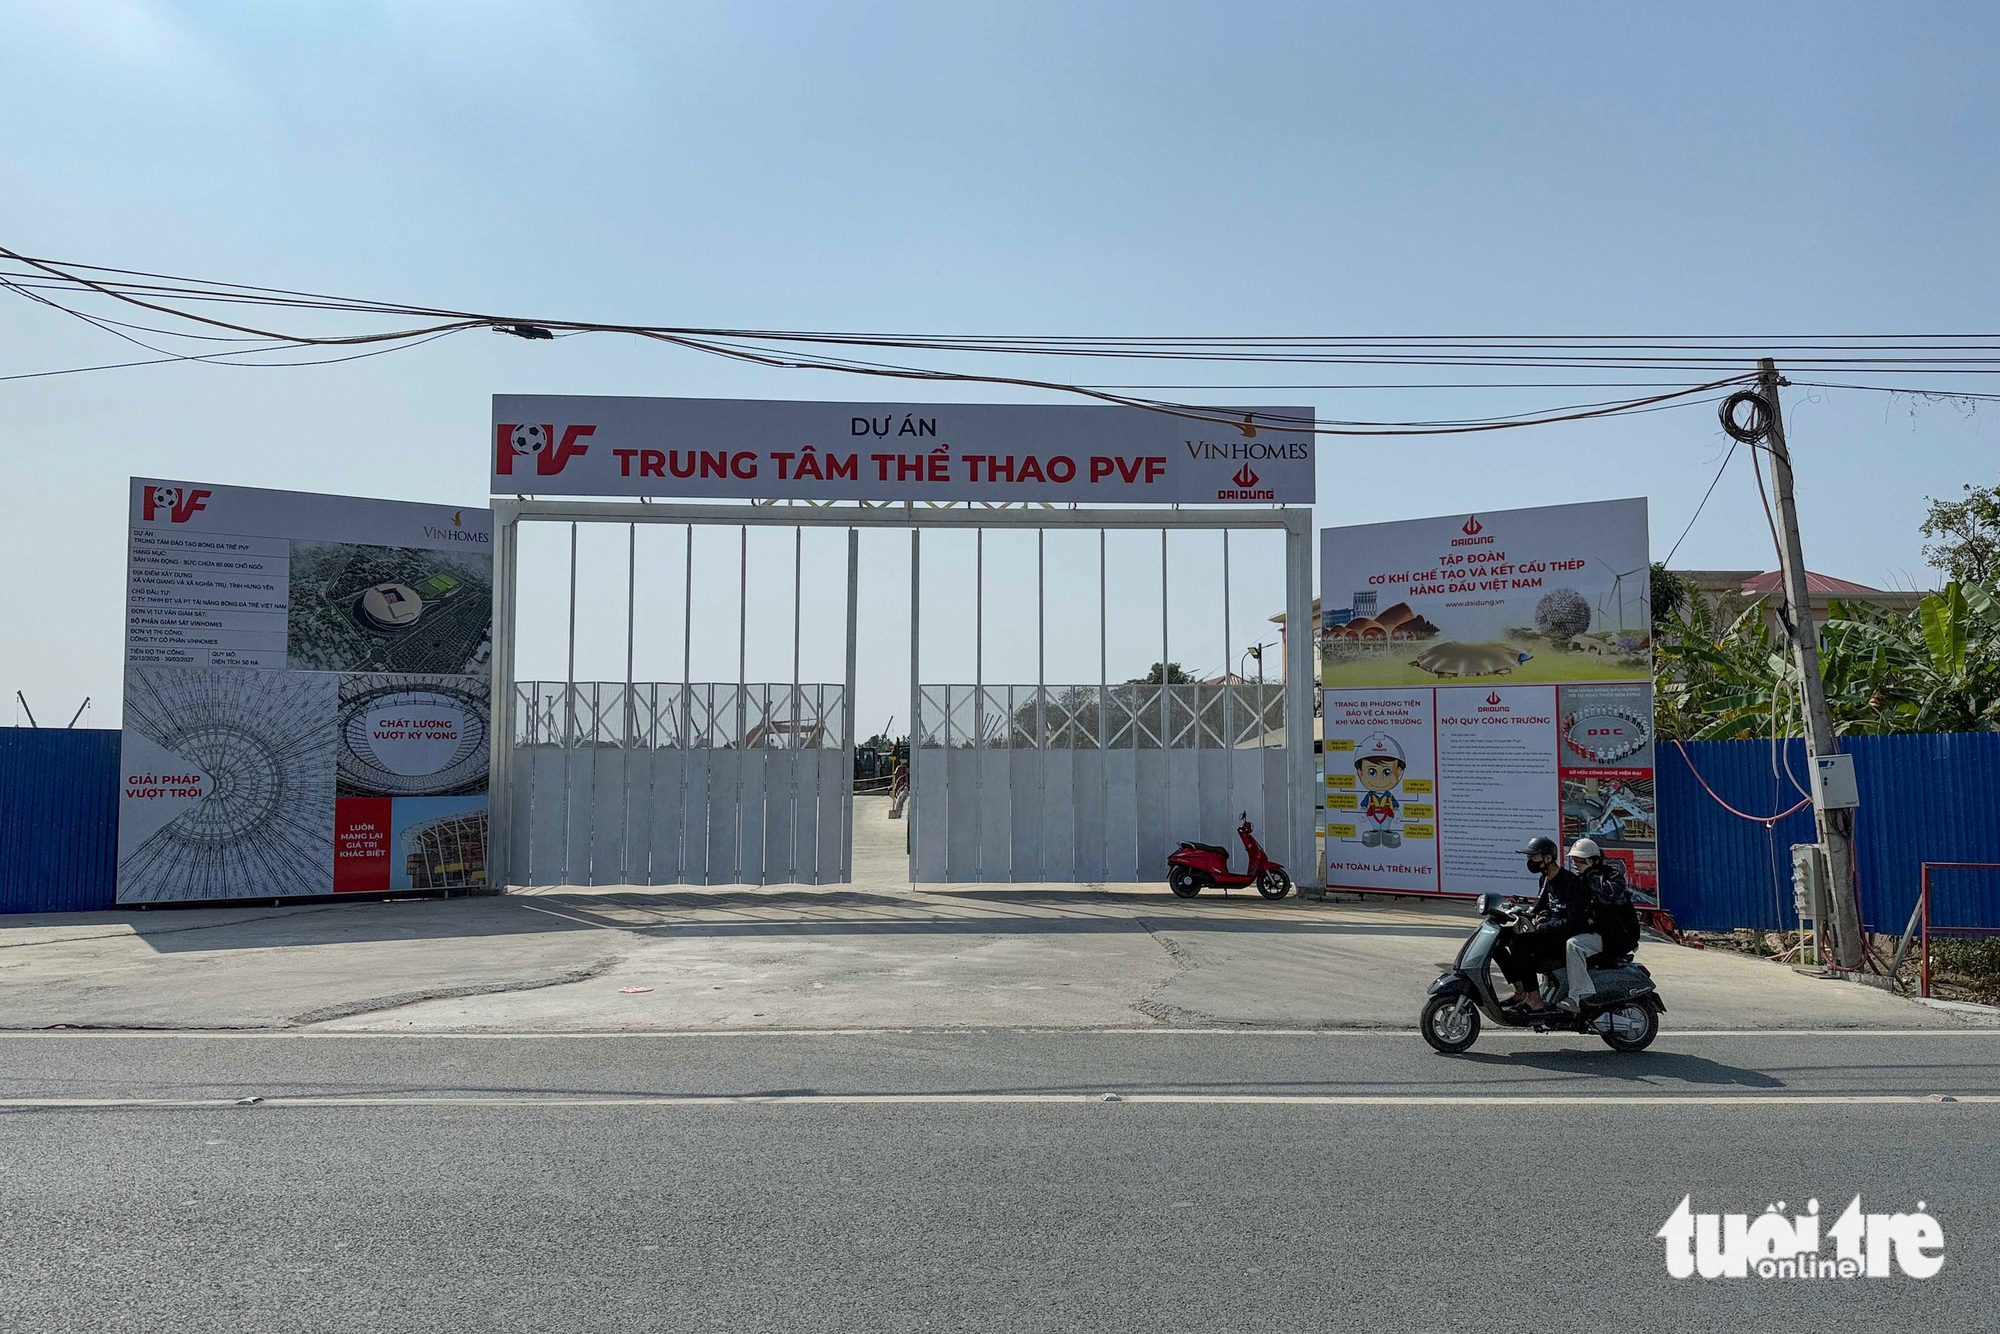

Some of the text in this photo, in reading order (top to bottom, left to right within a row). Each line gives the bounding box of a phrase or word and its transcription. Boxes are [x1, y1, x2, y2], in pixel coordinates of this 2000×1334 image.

[852, 413, 936, 439] DỰ ÁN
[1184, 440, 1308, 460] VINHOMES
[613, 443, 1166, 484] TRUNG TÂM THỂ THAO PVF
[1218, 489, 1274, 500] DAIDUNG
[423, 526, 488, 543] VINHOMES
[1451, 535, 1494, 547] DAIDUNG
[1439, 551, 1506, 567] TẬP ĐOÀN
[1368, 558, 1586, 585] CƠ KHÍ CHẾ TẠO VÀ KẾT CẤU THÉP
[1410, 577, 1543, 596] HÀNG ĐẦU VIỆT NAM
[1404, 700, 1421, 708] TIỆN
[379, 716, 452, 731] CHẤT LƯỢNG
[1441, 715, 1551, 727] NỘI QUY CÔNG TRƯỜNG
[373, 731, 406, 742] VƯỢT
[428, 731, 458, 742] VỌNG
[162, 773, 201, 785] PHÁP
[126, 785, 202, 800] VƯỢT TRỘI
[350, 822, 374, 832] LUÔN
[340, 831, 383, 841] MANG LẠI
[346, 839, 378, 851] GIÁ TRỊ
[339, 848, 386, 859] KHÁC BIỆT
[1330, 862, 1347, 871] AN
[1349, 861, 1372, 872] TOÀN
[1373, 861, 1385, 873] LÀ
[1386, 862, 1412, 874] TRÊN
[1414, 862, 1432, 875] HẾT
